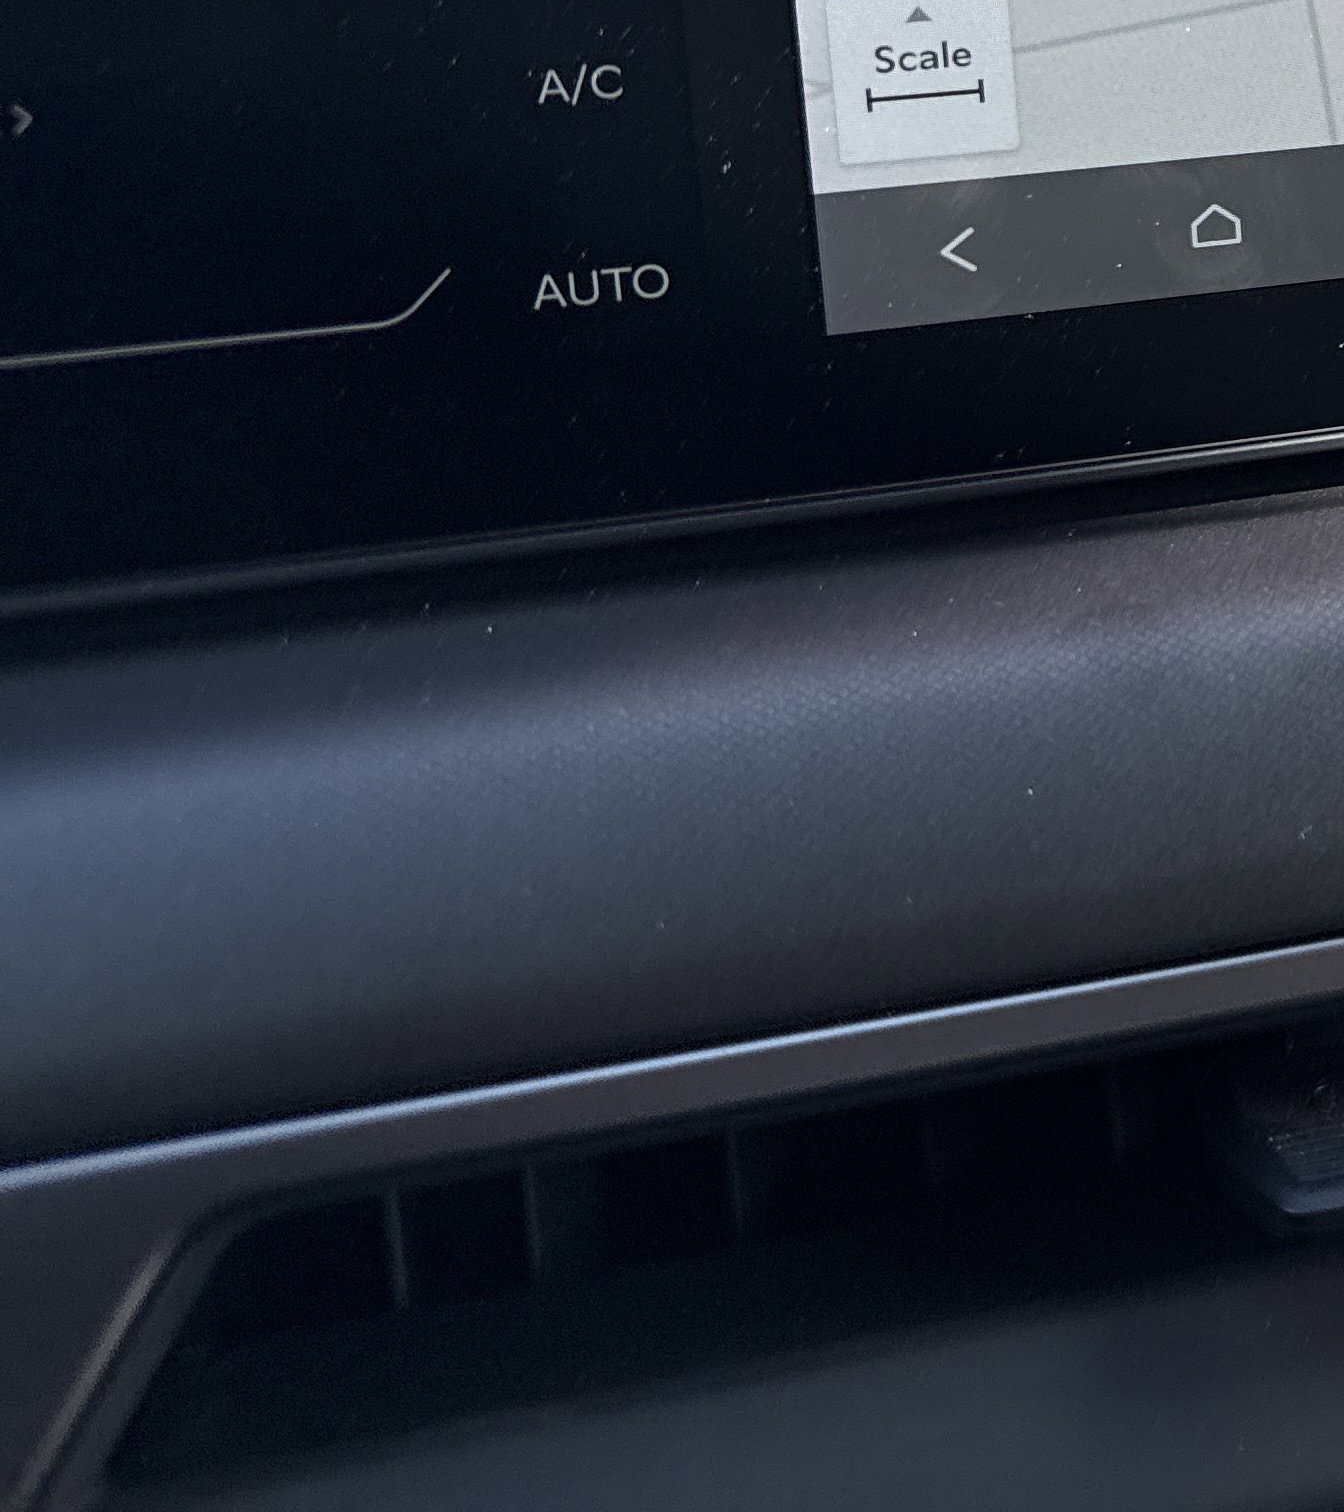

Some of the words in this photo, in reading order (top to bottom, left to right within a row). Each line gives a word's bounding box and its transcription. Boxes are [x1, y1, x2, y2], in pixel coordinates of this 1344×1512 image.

[874, 40, 972, 74] Scale
[538, 63, 624, 106] A/C
[533, 264, 669, 311] AUTO
